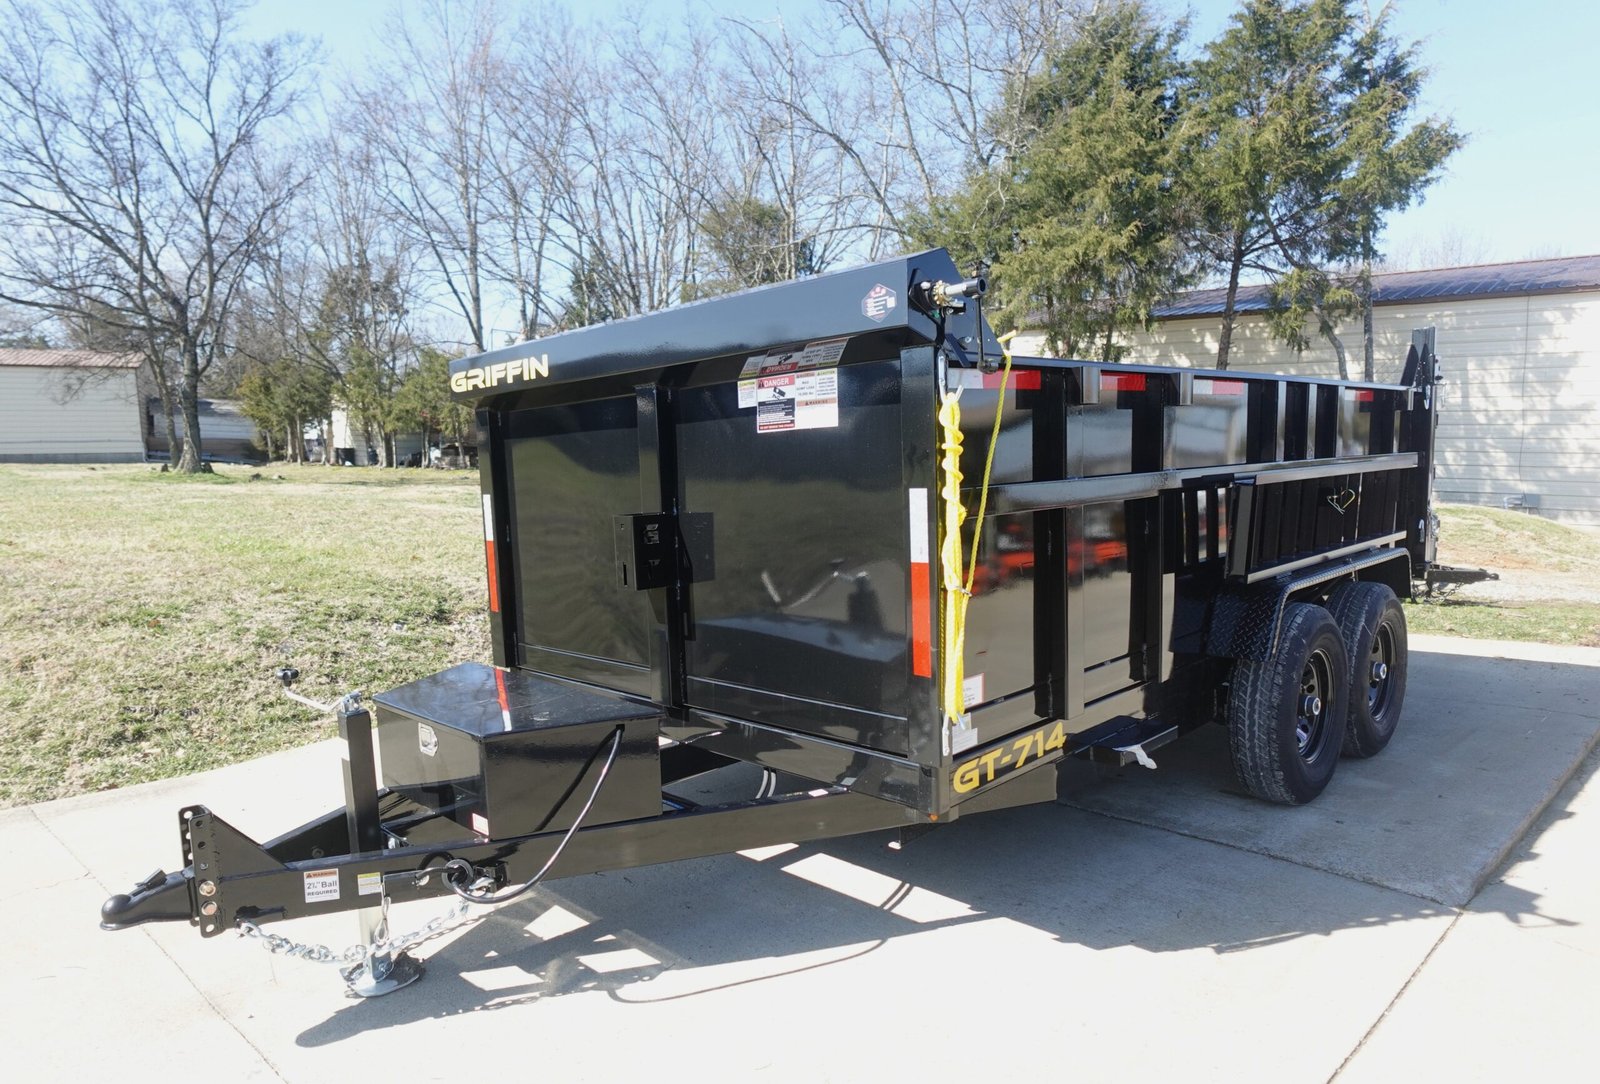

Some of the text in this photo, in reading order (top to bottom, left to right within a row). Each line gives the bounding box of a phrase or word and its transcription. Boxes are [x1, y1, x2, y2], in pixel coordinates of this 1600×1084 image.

[450, 353, 549, 393] GRIFFIN
[764, 377, 789, 387] DANGER
[953, 721, 1067, 793] GT-714
[321, 880, 338, 889] Ball
[306, 889, 338, 897] REQUIRED
